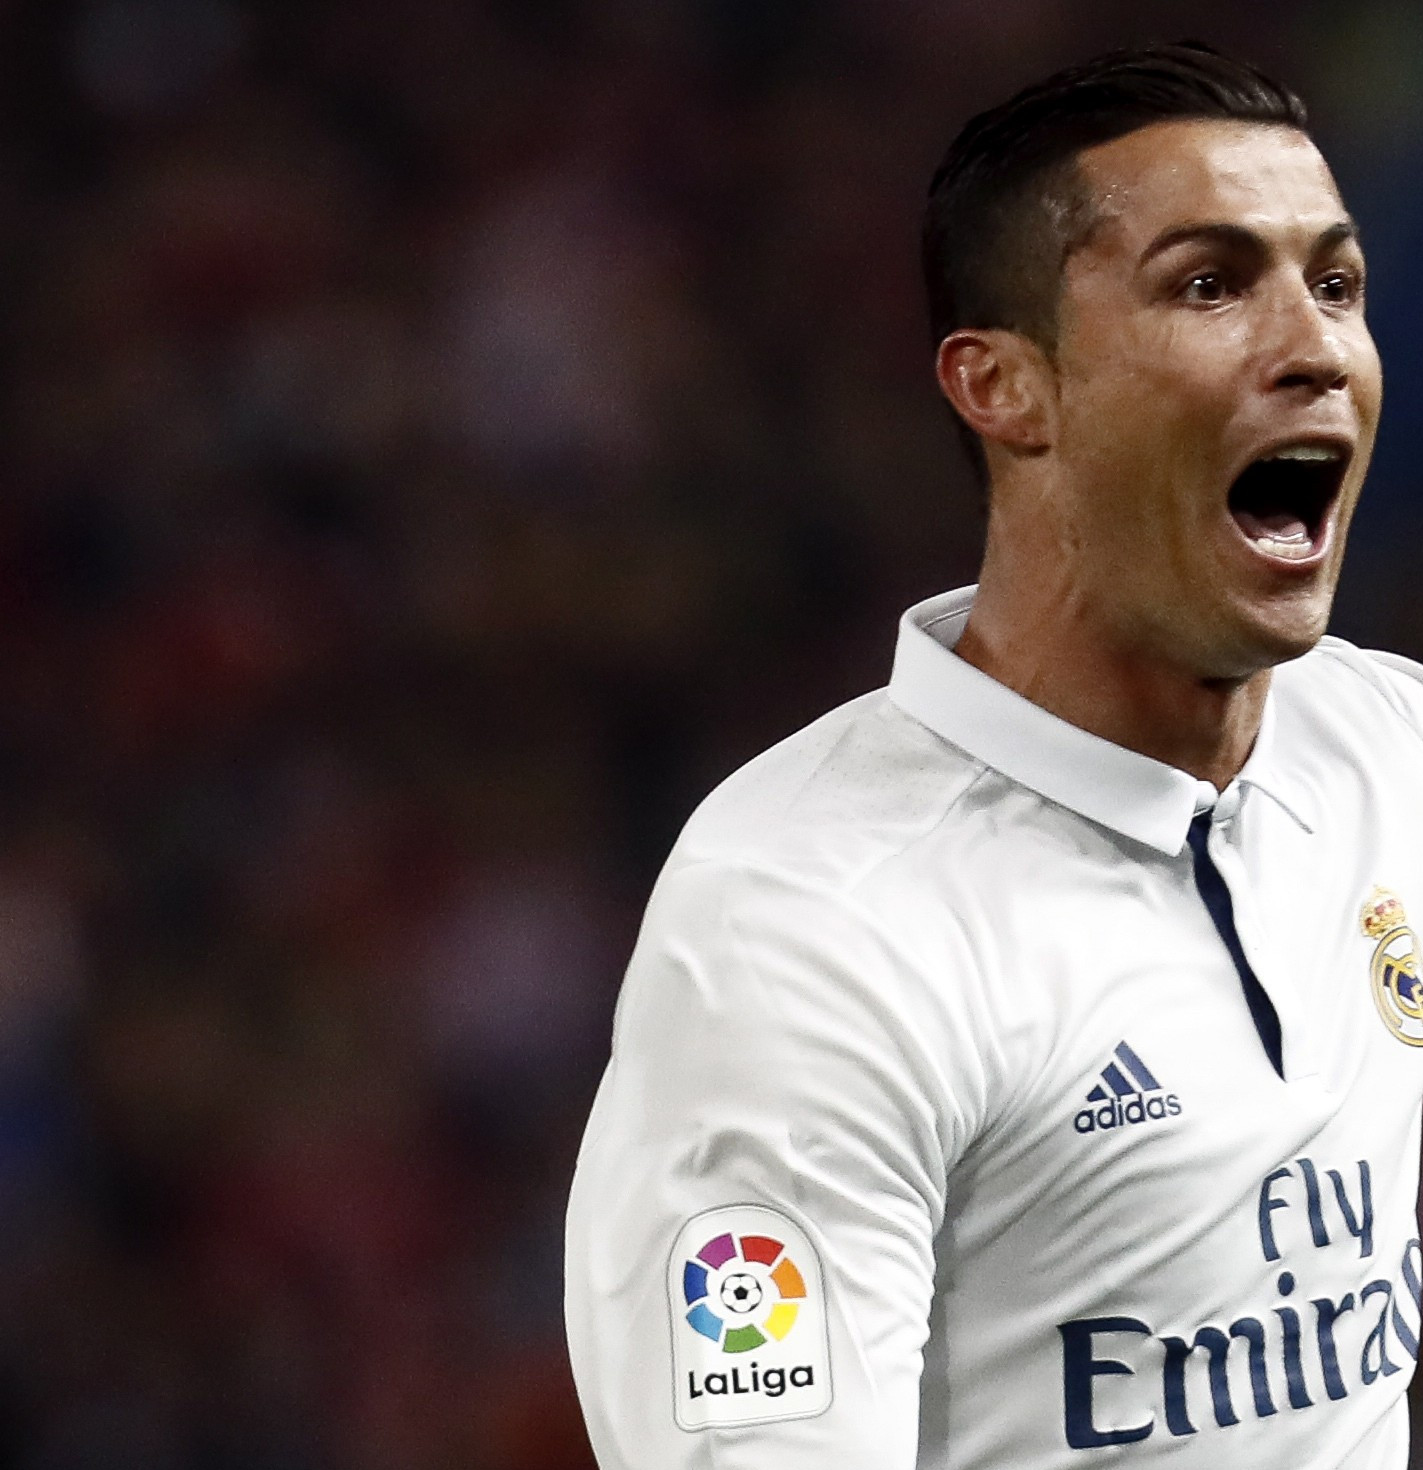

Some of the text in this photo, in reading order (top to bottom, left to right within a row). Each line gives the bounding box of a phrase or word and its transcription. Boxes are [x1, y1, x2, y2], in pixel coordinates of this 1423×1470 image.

[1074, 1093, 1182, 1133] adidas
[1258, 1158, 1373, 1262] Fly
[688, 1361, 815, 1400] LaLiga
